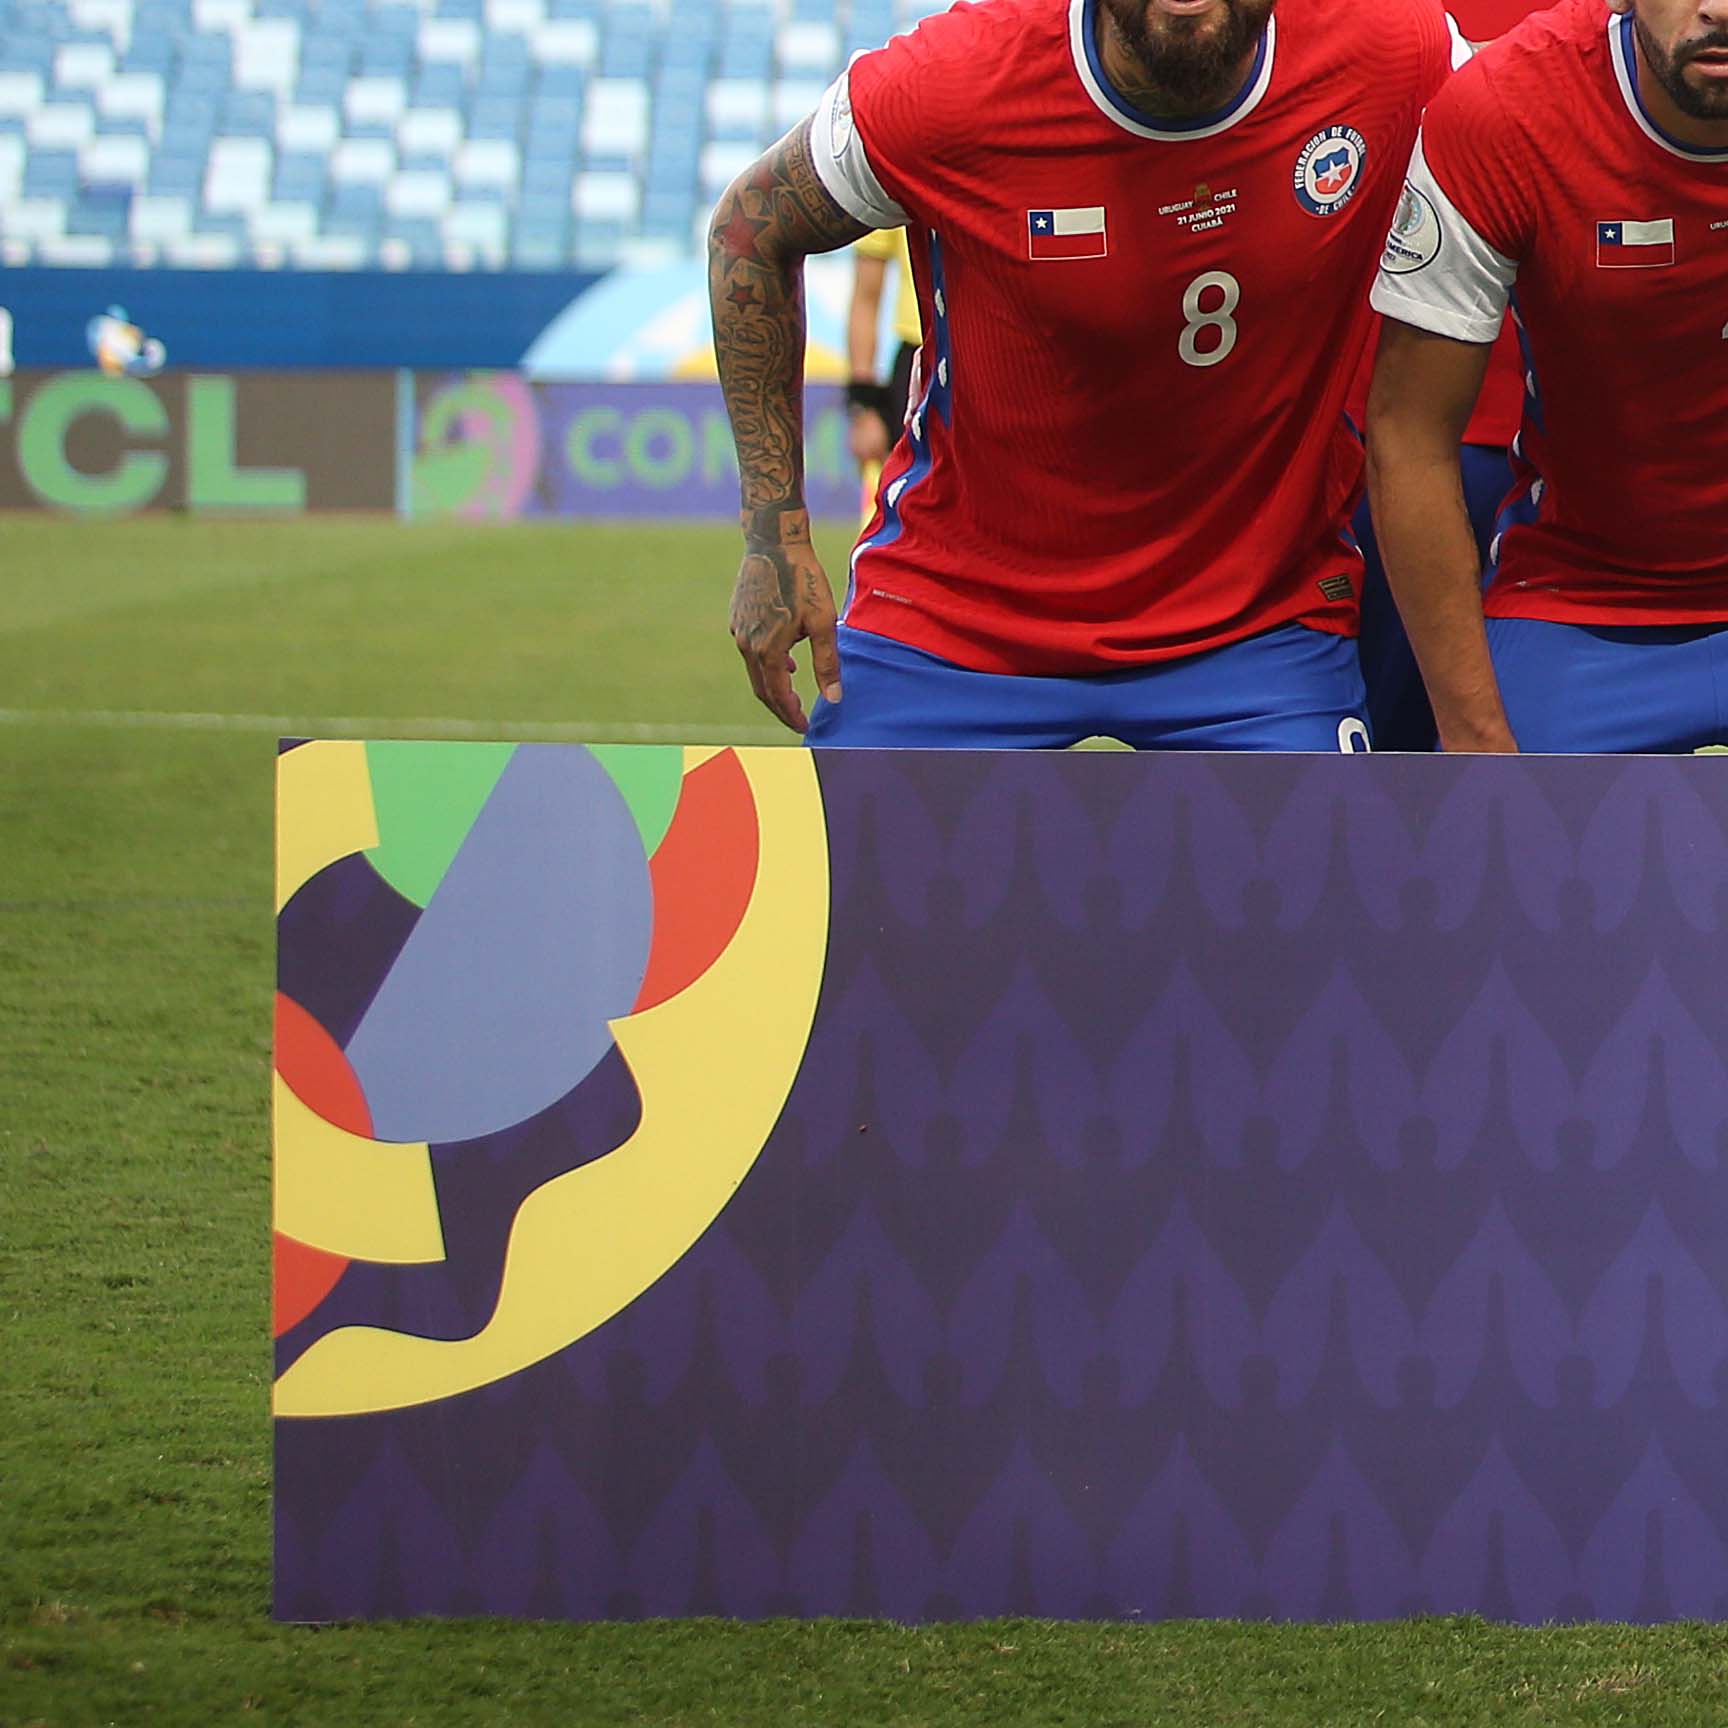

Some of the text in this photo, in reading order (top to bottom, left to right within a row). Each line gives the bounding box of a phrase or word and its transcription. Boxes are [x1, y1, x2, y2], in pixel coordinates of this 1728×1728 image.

[1294, 131, 1326, 189] FEDERACION
[1331, 126, 1343, 137] DE
[1214, 189, 1237, 202] CHILE
[1214, 203, 1236, 215] 2021
[1178, 271, 1240, 366] 8
[0, 372, 307, 516] CL
